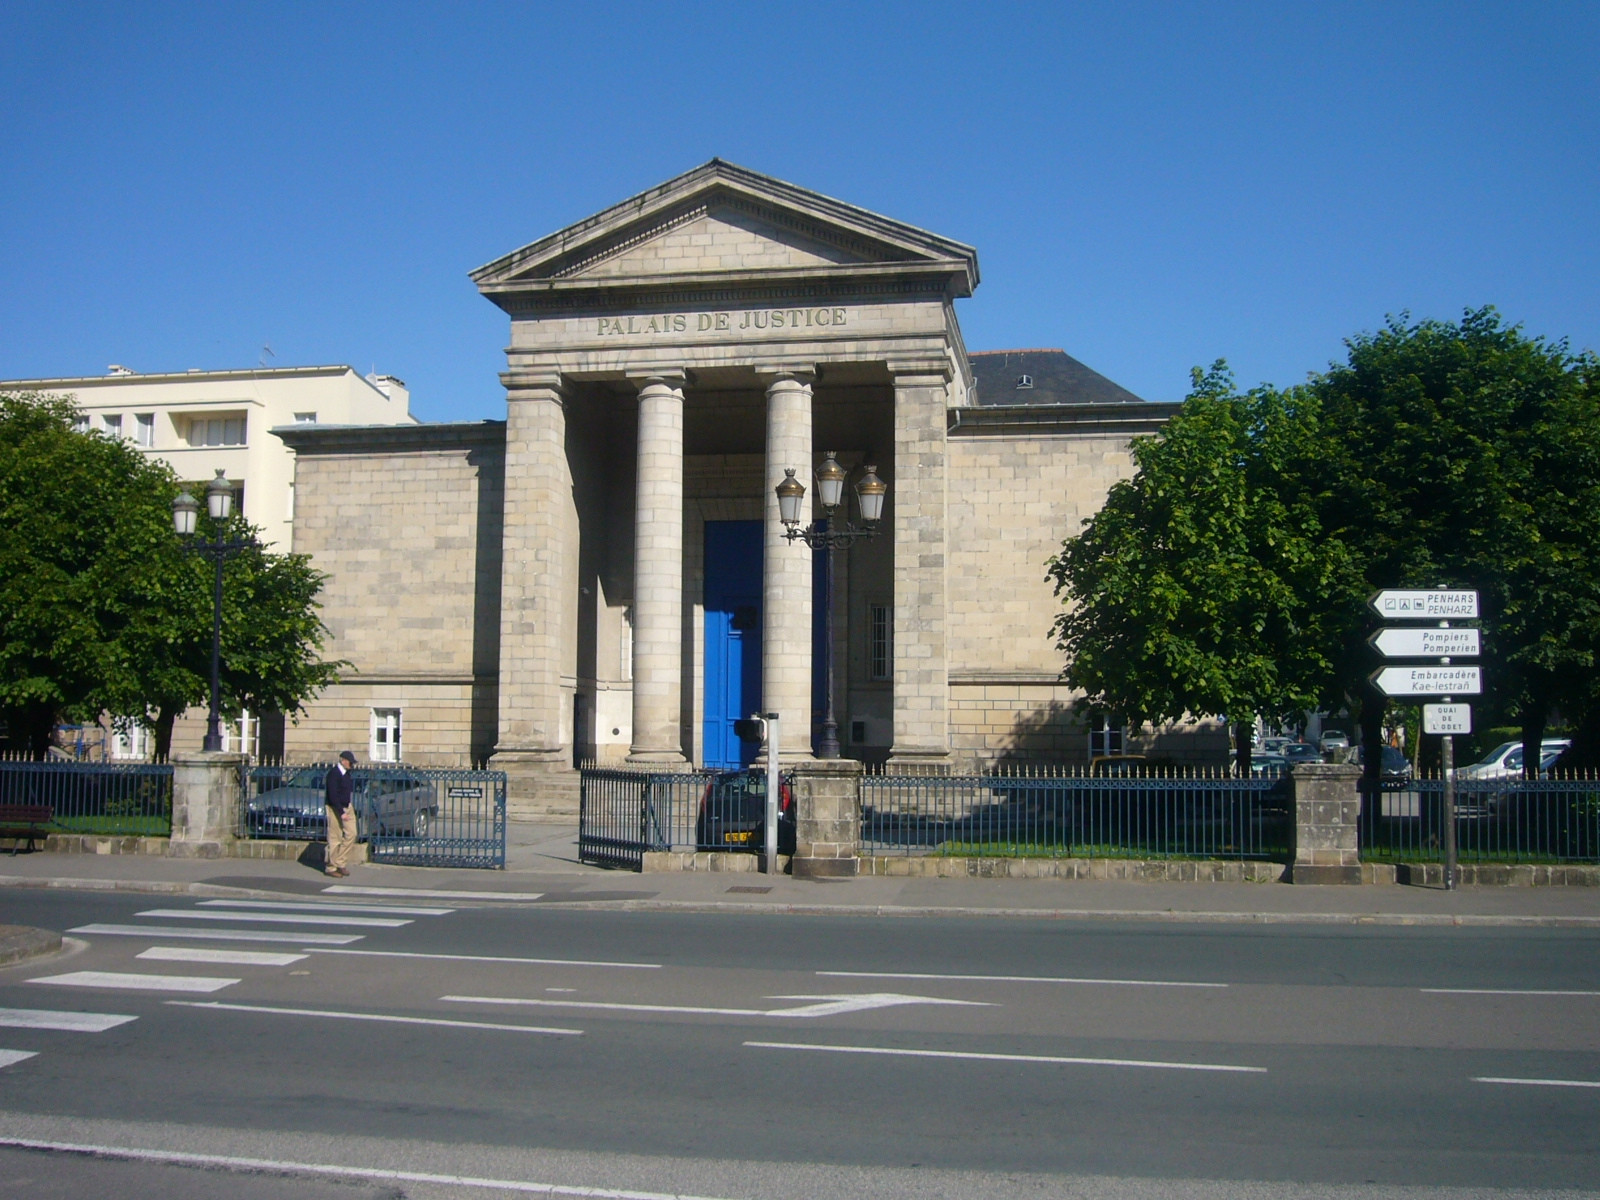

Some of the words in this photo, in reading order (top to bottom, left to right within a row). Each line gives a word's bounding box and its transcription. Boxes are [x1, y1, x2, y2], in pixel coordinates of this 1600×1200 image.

[596, 314, 687, 336] PALAIS
[697, 312, 731, 332] DE
[739, 307, 848, 330] JUSTICE
[1427, 594, 1474, 603] PENHARS
[1427, 605, 1473, 614] PENHARZ
[1422, 632, 1469, 643] Pompiers
[1423, 644, 1477, 654] Pomperien
[1411, 670, 1477, 680] Embarcadère
[1411, 681, 1470, 691] Kae-lestrañ
